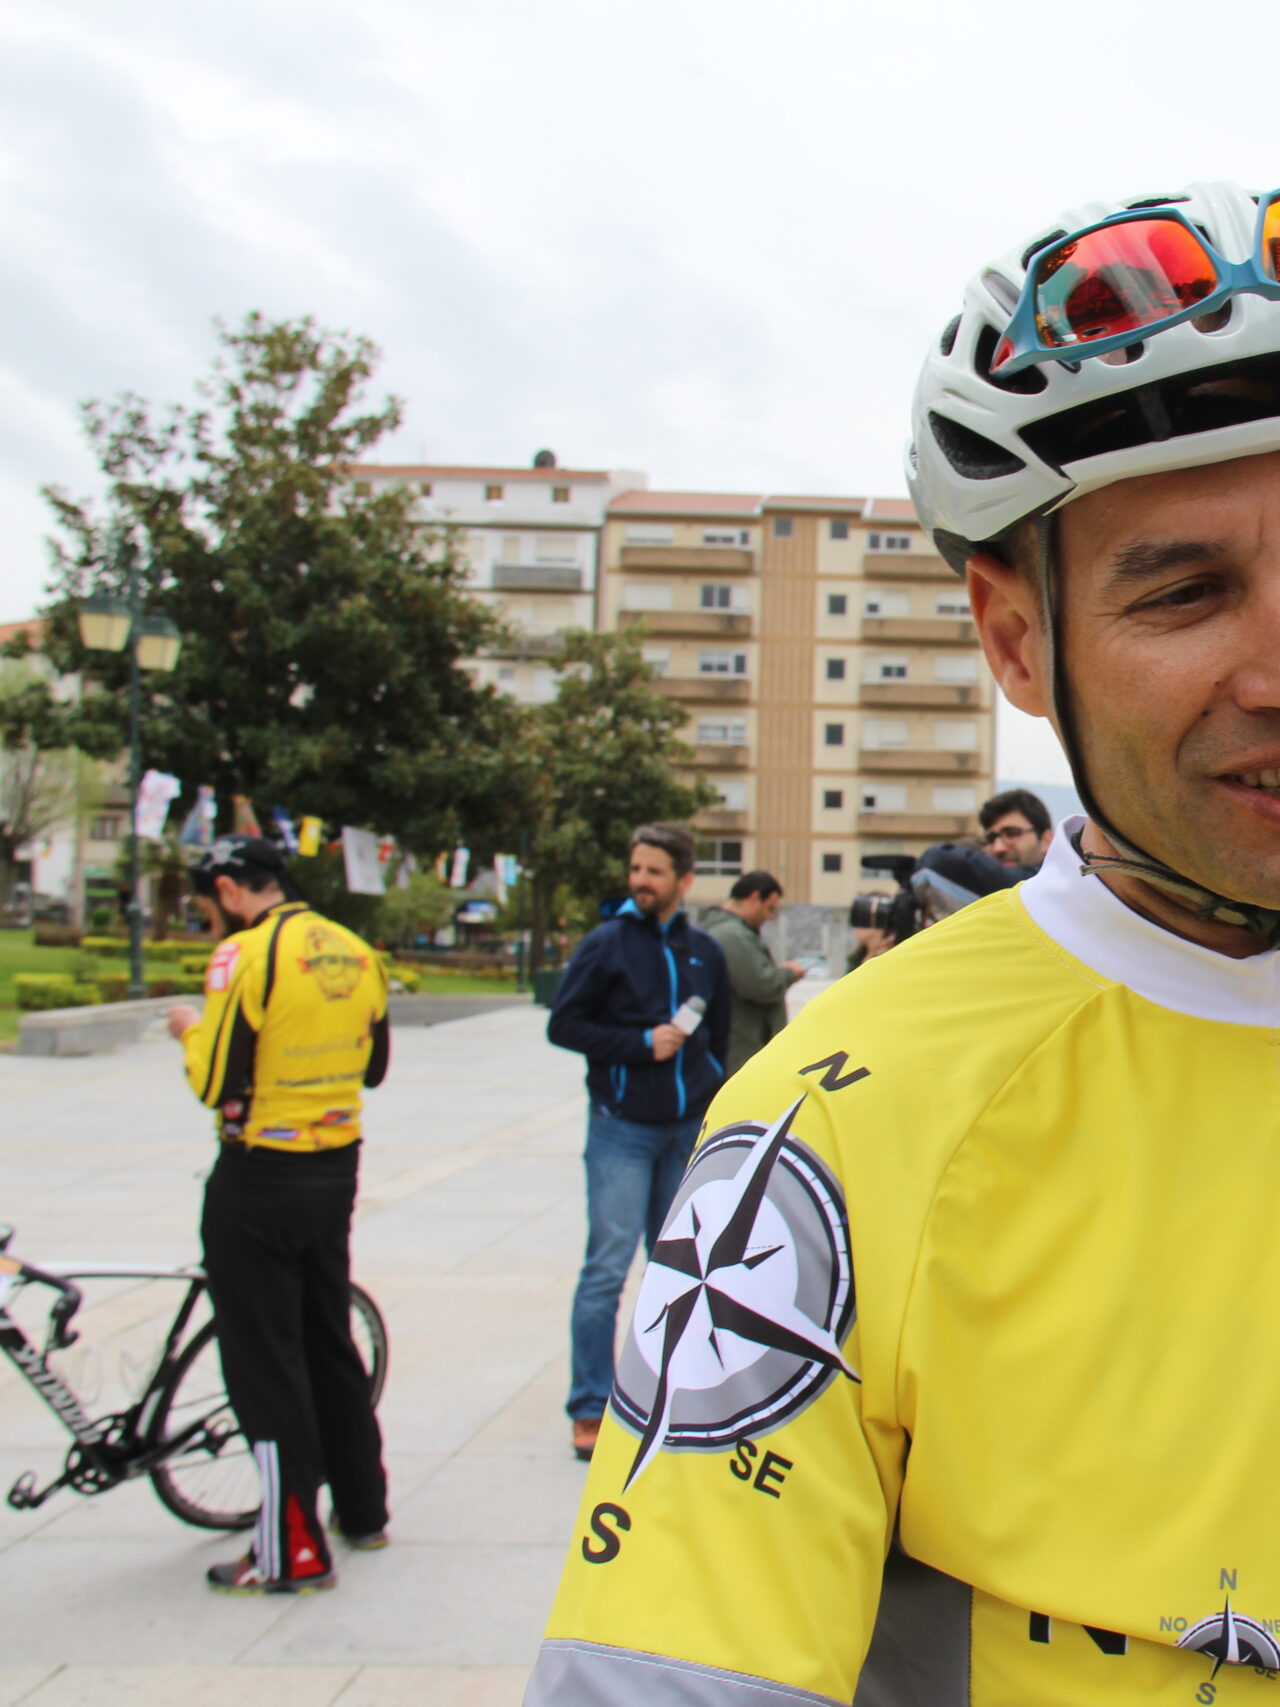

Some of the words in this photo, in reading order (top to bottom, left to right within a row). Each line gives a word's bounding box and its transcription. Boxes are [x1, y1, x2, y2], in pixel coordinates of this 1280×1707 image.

[798, 1050, 872, 1092] N
[729, 1439, 794, 1499] SE
[580, 1502, 632, 1564] S
[1219, 1567, 1237, 1591] N
[1159, 1616, 1188, 1632] NO
[1195, 1681, 1218, 1706] S
